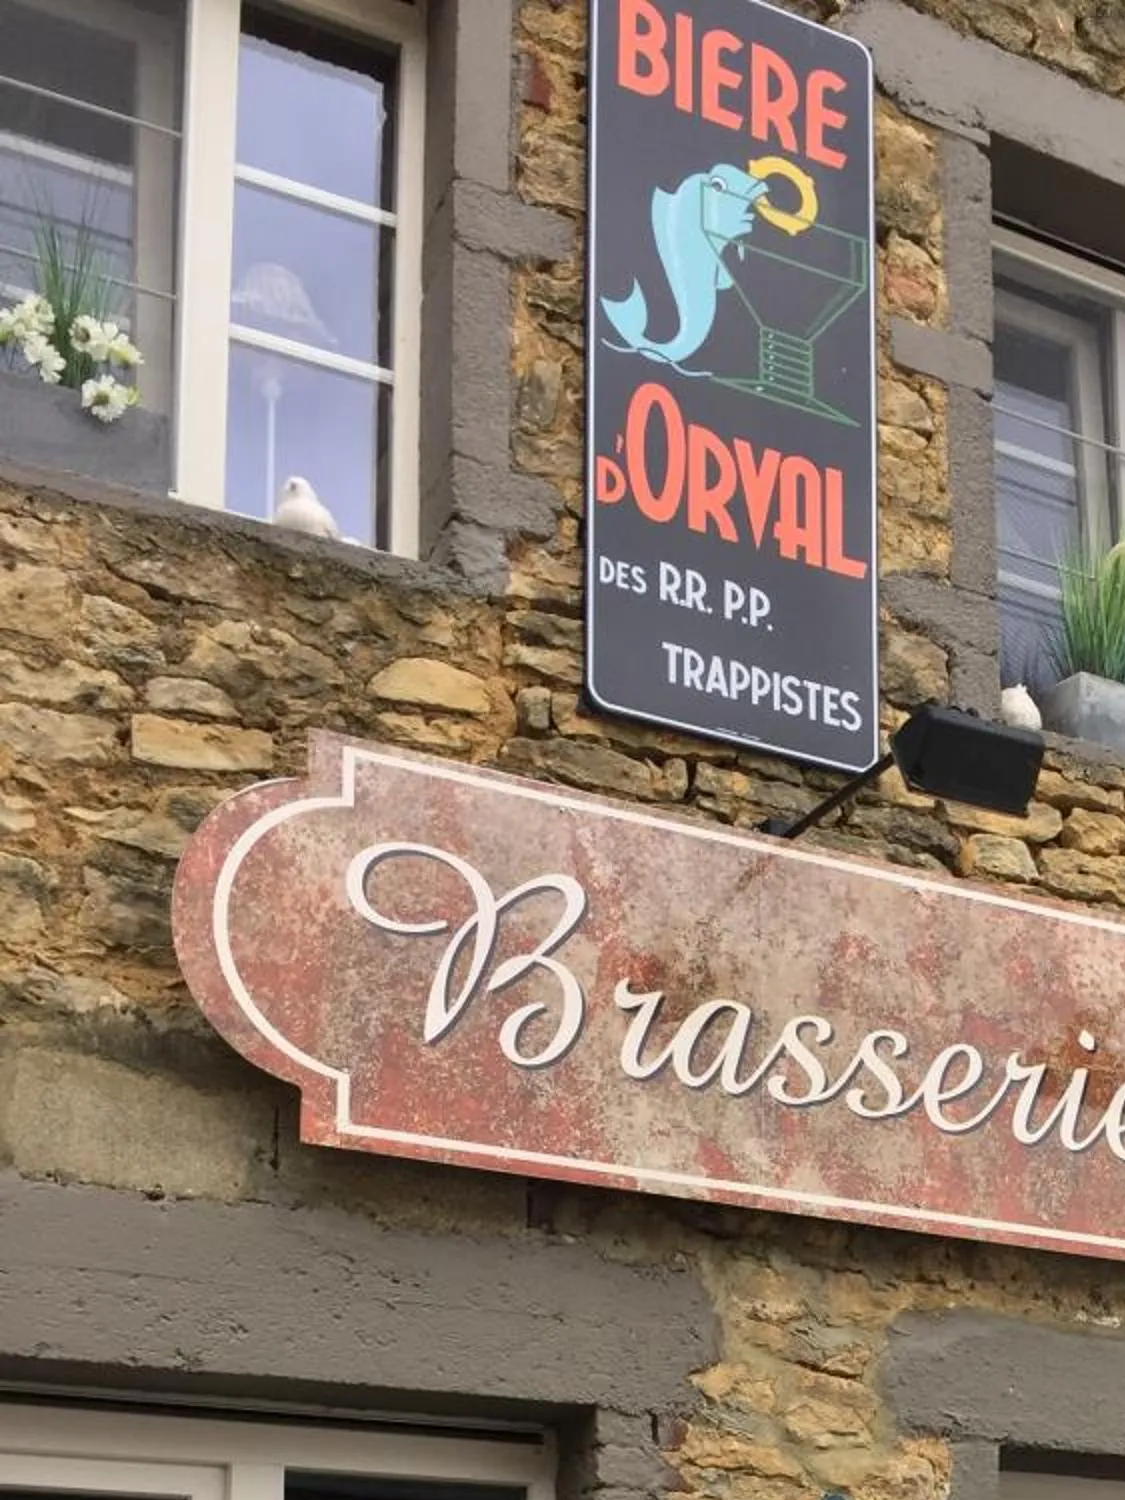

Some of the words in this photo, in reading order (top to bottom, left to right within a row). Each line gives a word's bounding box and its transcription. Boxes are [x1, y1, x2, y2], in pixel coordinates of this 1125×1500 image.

[618, 0, 848, 169] BIERE
[600, 555, 647, 594] DES
[662, 641, 863, 731] TRAPPISTES
